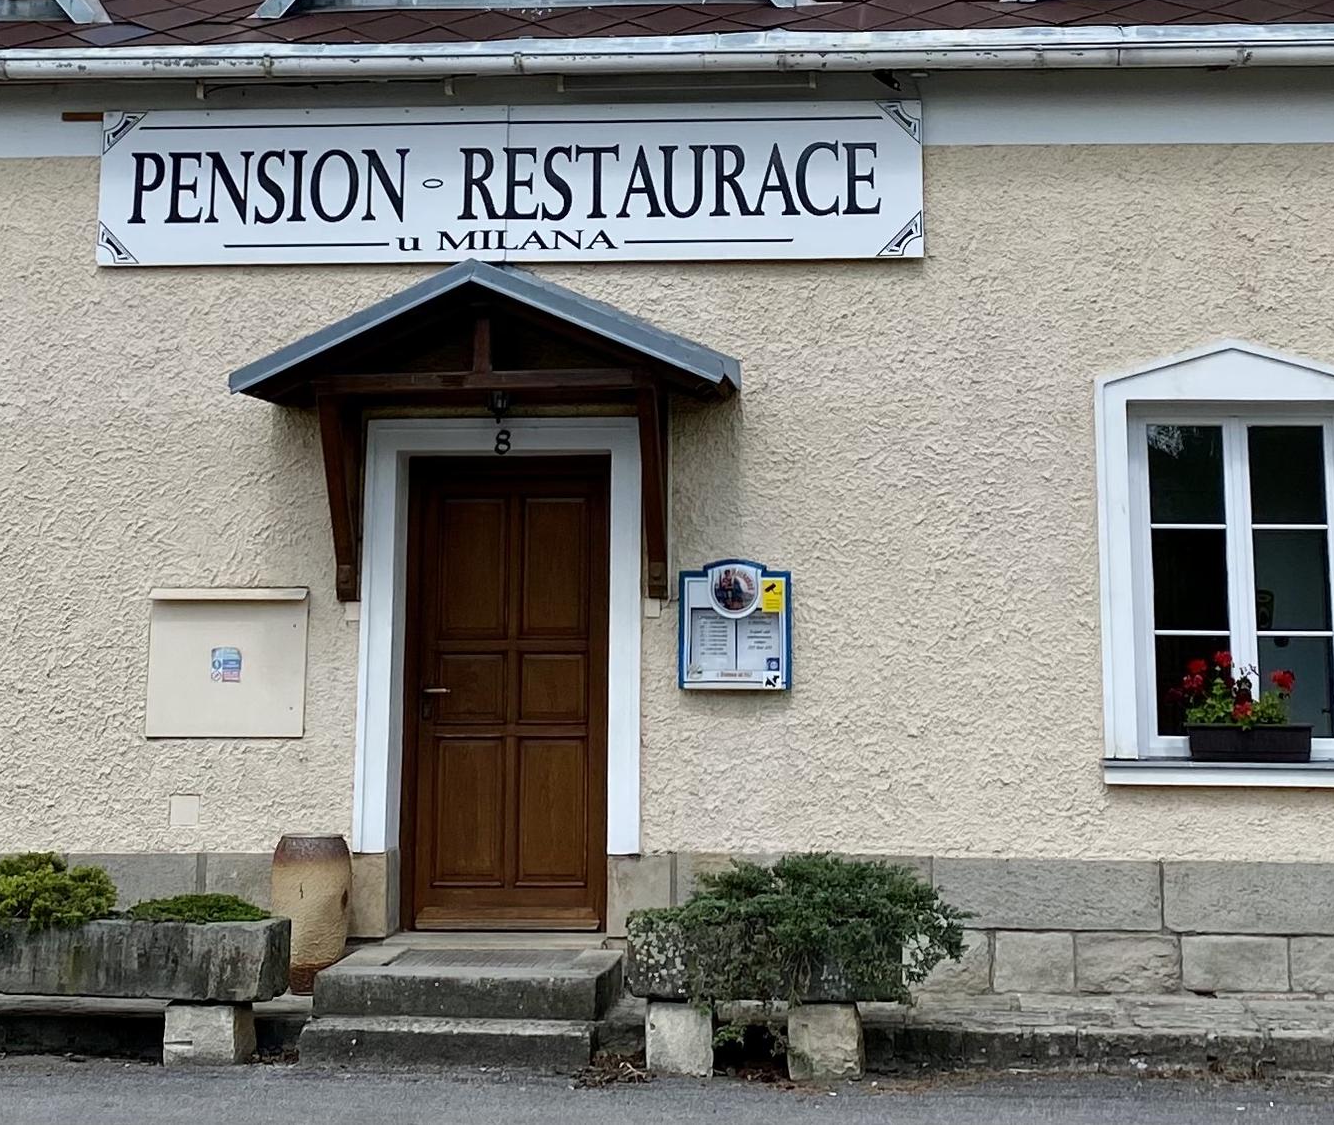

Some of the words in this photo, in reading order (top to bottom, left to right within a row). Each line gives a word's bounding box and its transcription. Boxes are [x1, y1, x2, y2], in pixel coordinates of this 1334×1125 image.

[127, 148, 411, 225] PENSION
[457, 139, 882, 222] RESTAURACE
[396, 236, 422, 252] u
[436, 229, 619, 251] MILANA
[494, 429, 511, 455] 8
